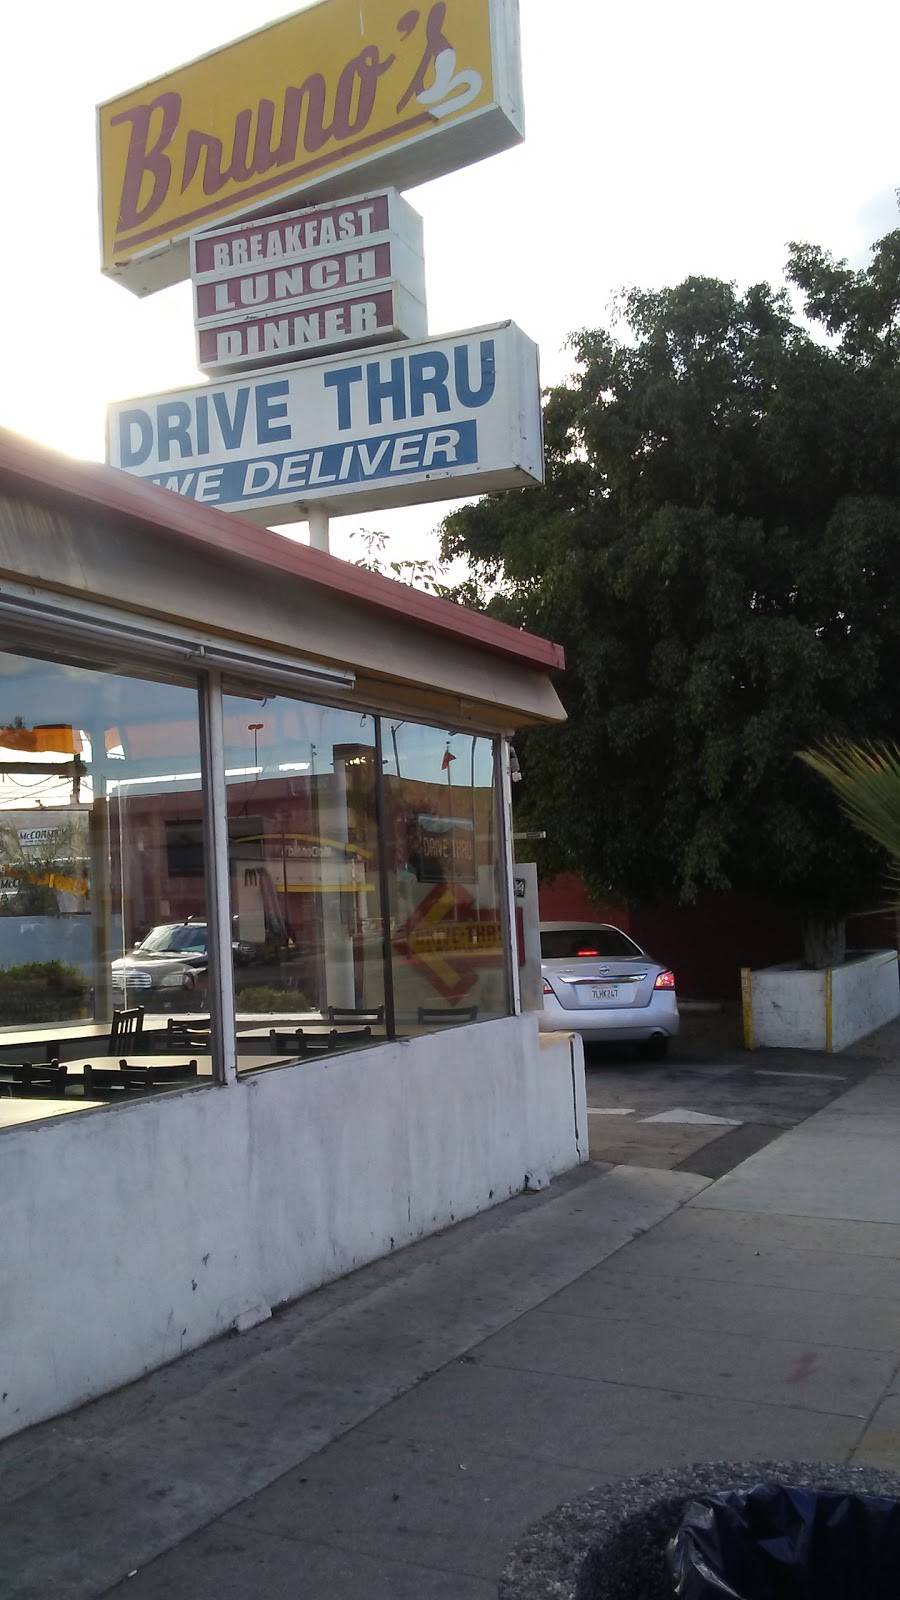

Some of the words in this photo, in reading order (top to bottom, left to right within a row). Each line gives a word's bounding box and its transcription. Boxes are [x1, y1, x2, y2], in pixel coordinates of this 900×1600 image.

[110, 1, 476, 233] Bruno's
[213, 207, 376, 271] BREAKFAST
[215, 249, 376, 312] LUNCH
[216, 302, 378, 360] DINNER
[118, 380, 292, 468] DRIVE
[323, 339, 496, 431] THRU
[241, 429, 461, 496] DELIVER
